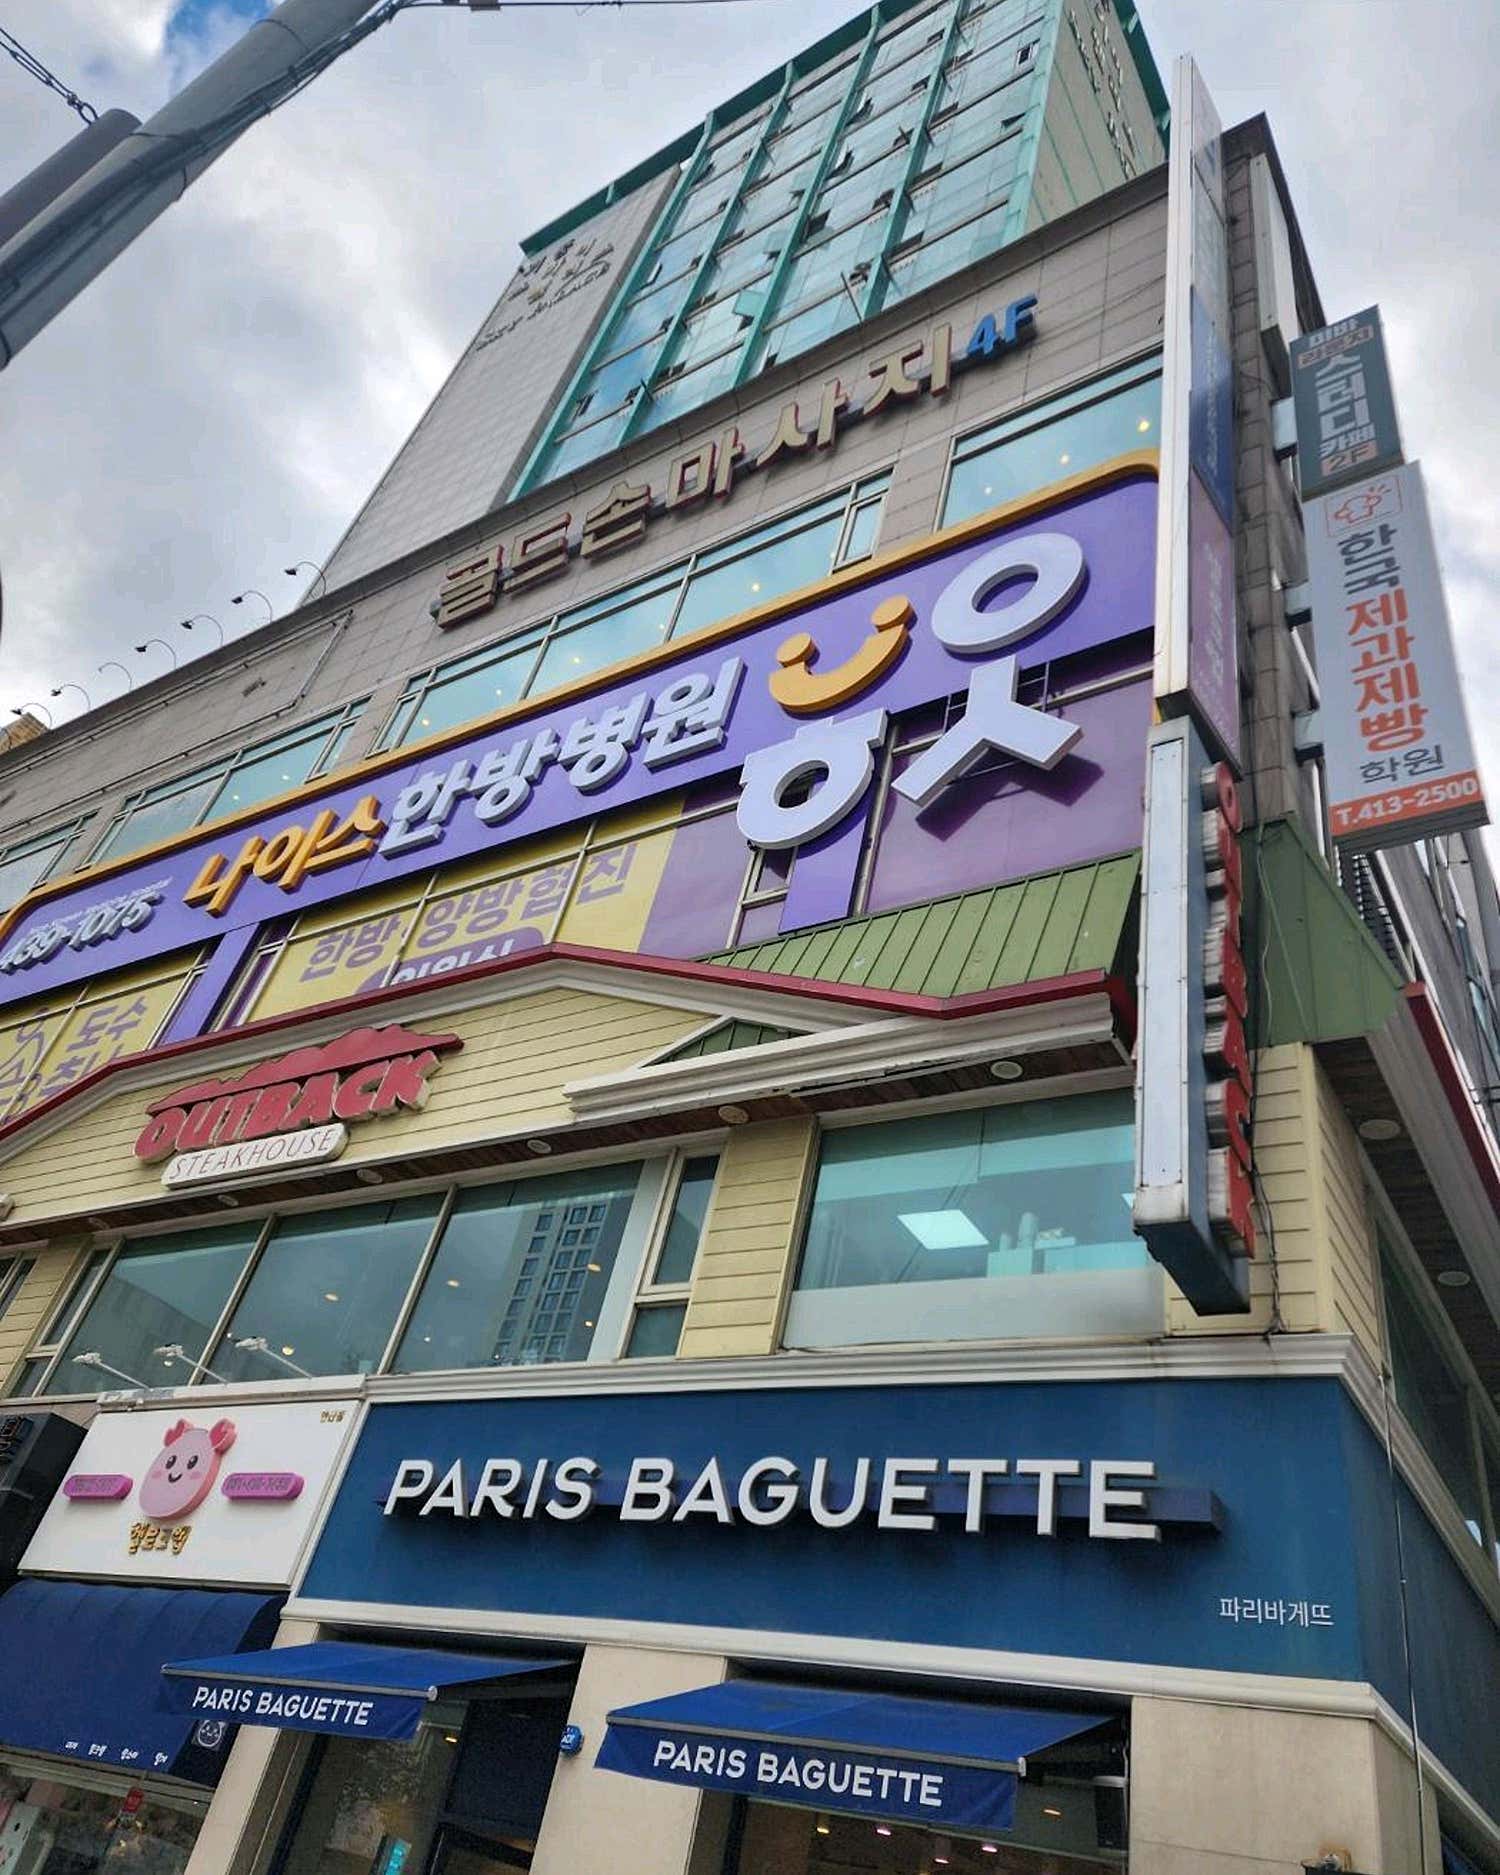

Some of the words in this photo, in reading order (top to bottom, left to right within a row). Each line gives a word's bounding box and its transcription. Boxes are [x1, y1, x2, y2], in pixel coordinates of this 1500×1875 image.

[966, 293, 1038, 357] 4F
[1327, 444, 1370, 472] 2F
[1345, 587, 1429, 753] 제과제빵
[1359, 744, 1445, 784] 학원
[1336, 778, 1479, 826] T.413-2500
[66, 996, 148, 1053] 도수
[132, 1049, 442, 1163] OUTBACK
[169, 1128, 336, 1180] STEAKHOUSE
[382, 1457, 596, 1520] PARIS
[618, 1457, 1161, 1540] BAGUETTE
[1219, 1596, 1335, 1628] 파리바게뜨
[192, 1686, 254, 1713] PARIS
[255, 1690, 374, 1726] BAGUETTE
[653, 1739, 748, 1778] PARIS
[757, 1751, 944, 1807] BAGUETTE
